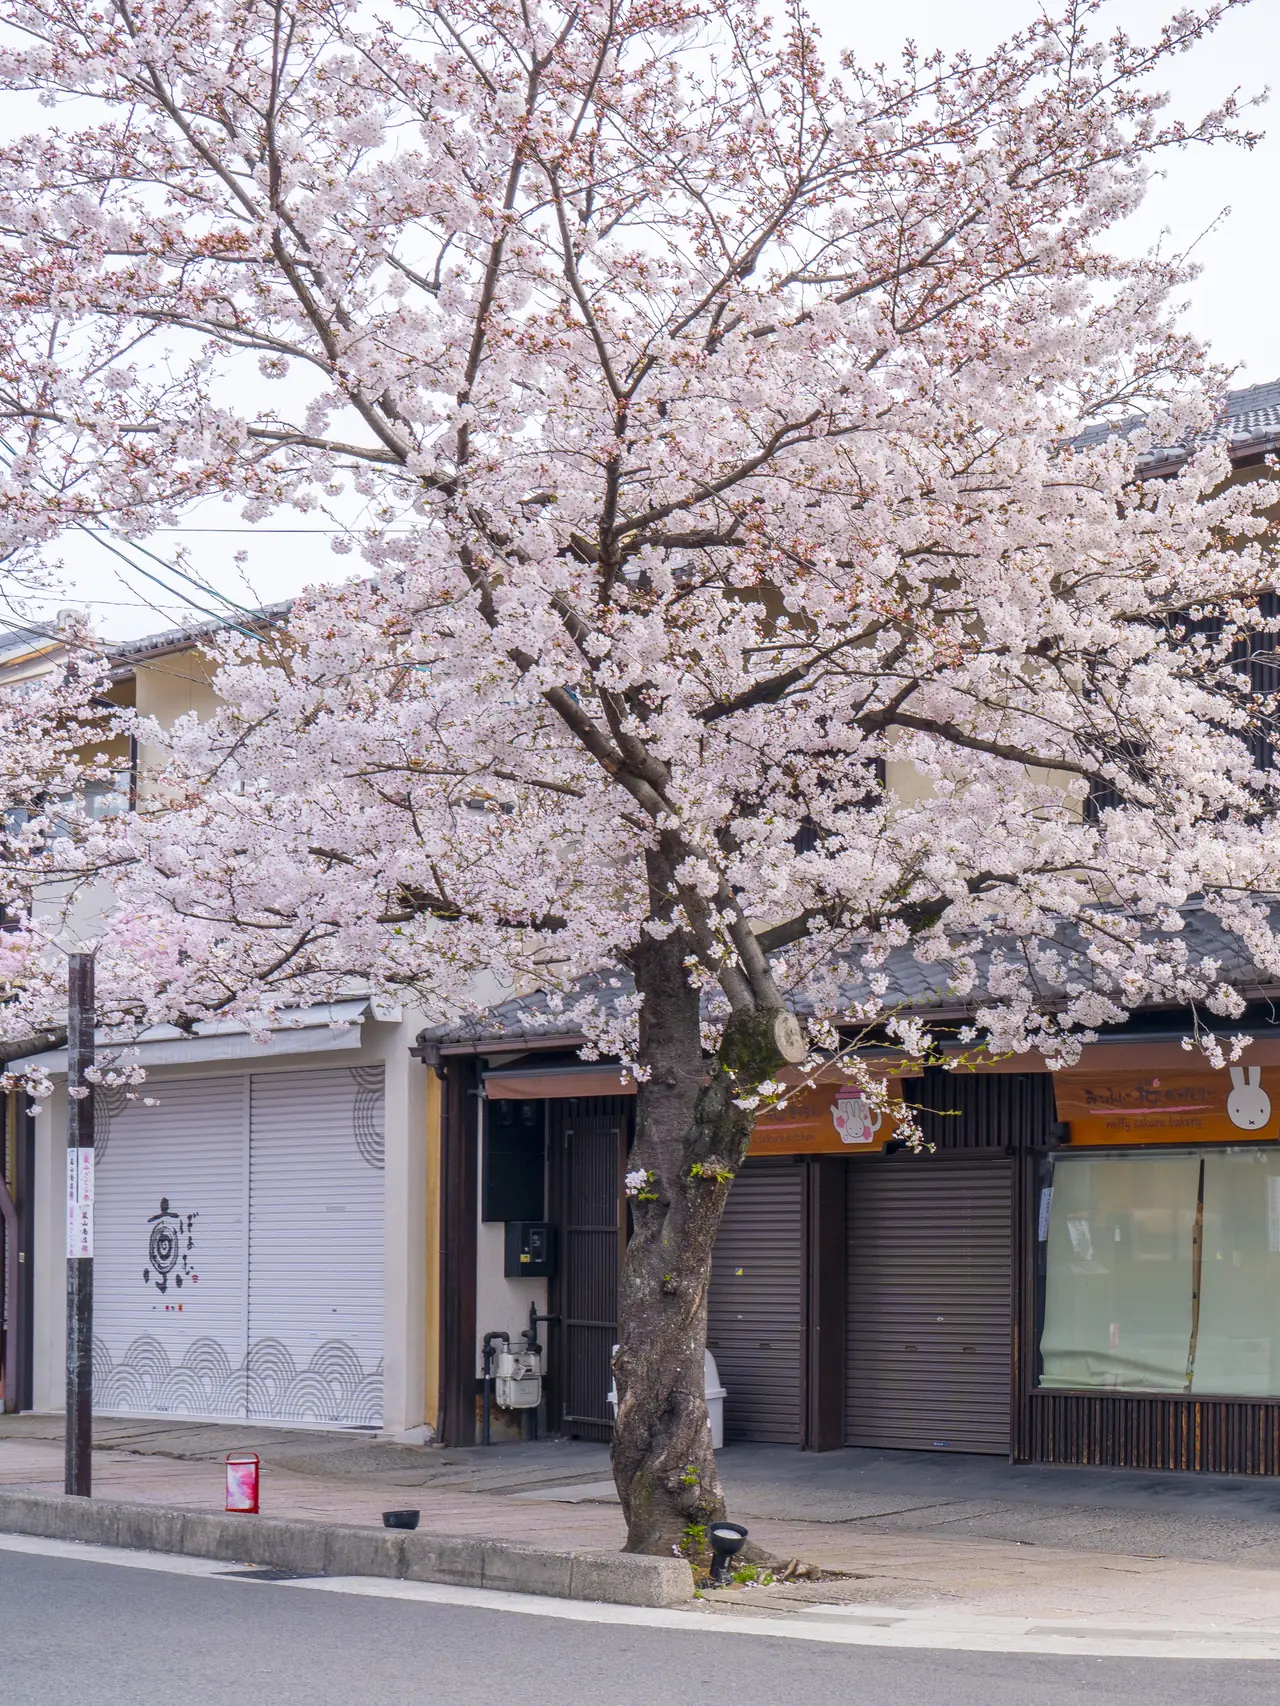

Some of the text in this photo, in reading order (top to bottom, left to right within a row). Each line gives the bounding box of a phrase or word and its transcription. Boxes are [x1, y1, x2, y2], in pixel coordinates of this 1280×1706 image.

[1106, 1113, 1202, 1132] miffy sakura bakery
